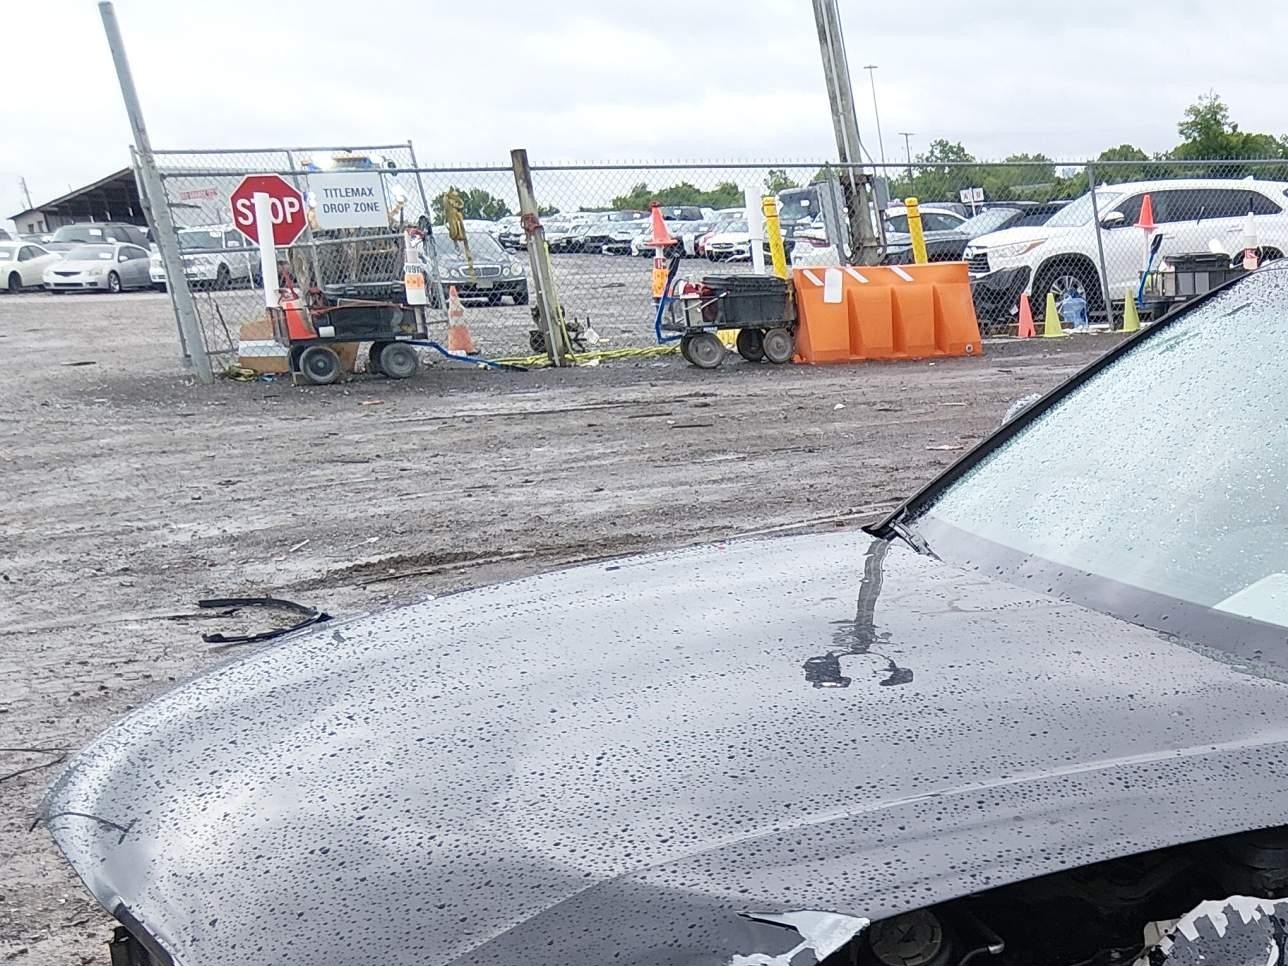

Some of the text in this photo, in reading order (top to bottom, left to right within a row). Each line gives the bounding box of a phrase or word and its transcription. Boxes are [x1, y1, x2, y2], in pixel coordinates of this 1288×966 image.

[323, 187, 375, 198] TITLEMAX
[236, 196, 300, 226] SOP
[323, 201, 381, 214] DROP ZONE
